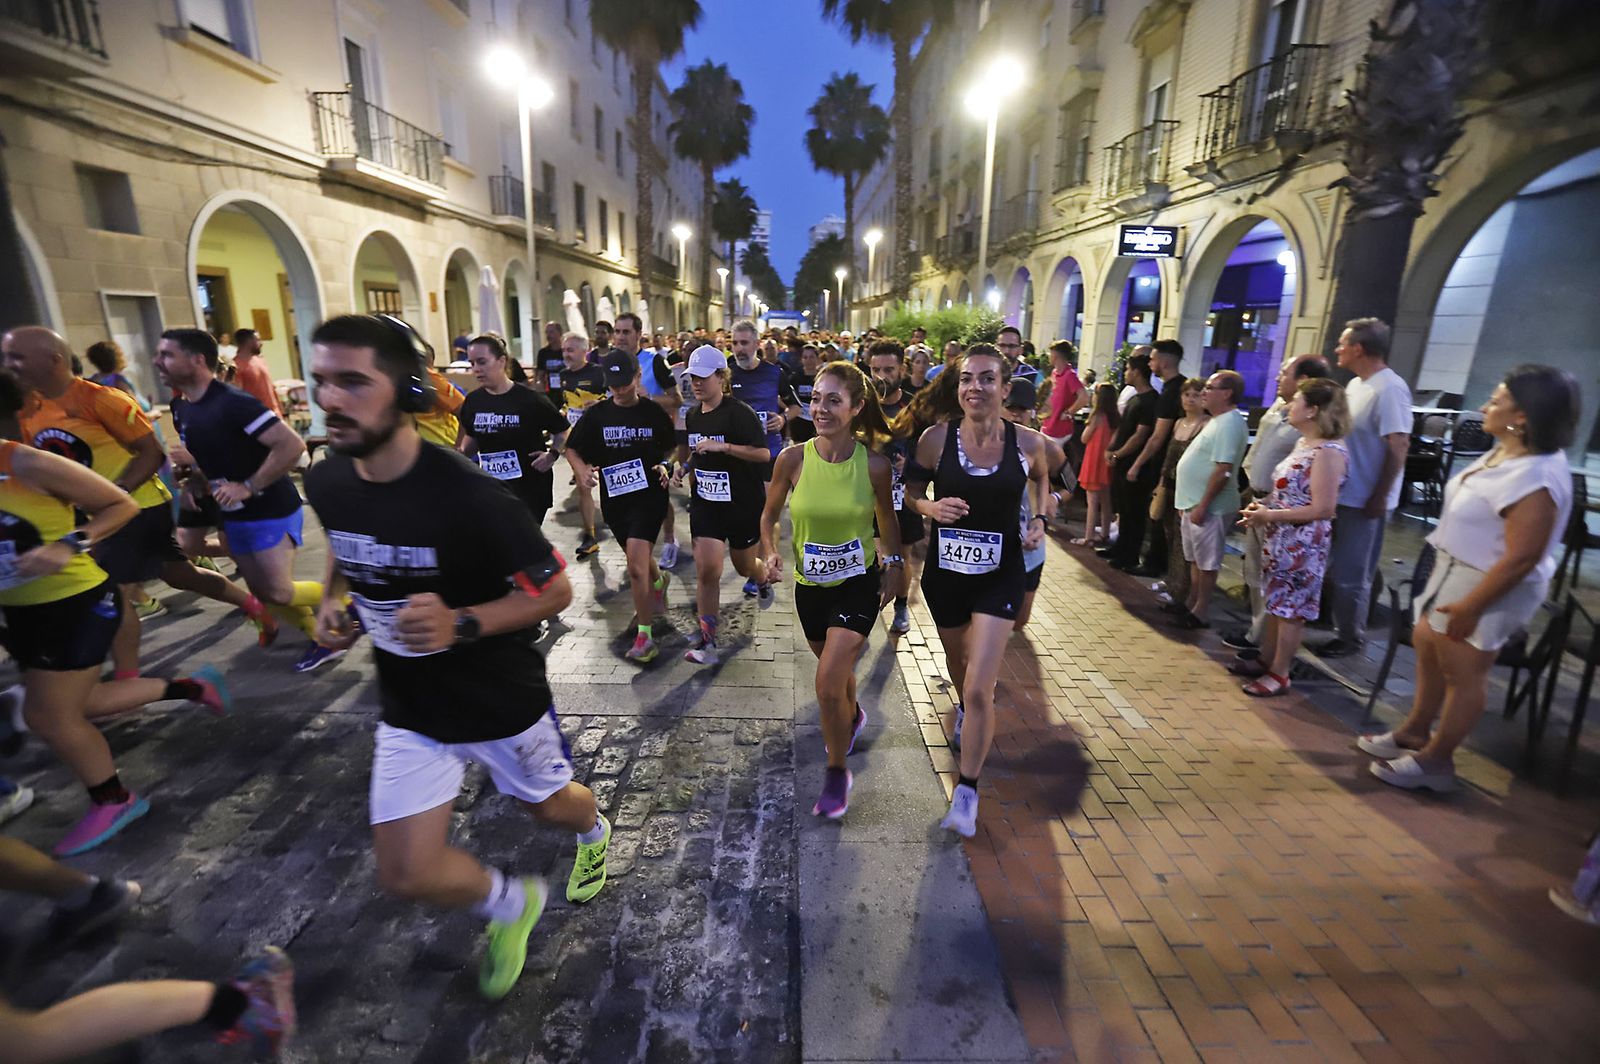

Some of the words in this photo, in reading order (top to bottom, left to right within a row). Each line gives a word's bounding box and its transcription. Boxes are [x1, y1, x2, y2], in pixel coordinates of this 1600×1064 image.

[504, 414, 520, 424] FUN
[604, 428, 620, 439] RUN
[621, 428, 637, 438] FOR
[637, 427, 653, 437] FUN
[492, 462, 509, 473] 406
[616, 472, 635, 486] 405
[953, 545, 982, 563] 479
[819, 558, 847, 574] 299
